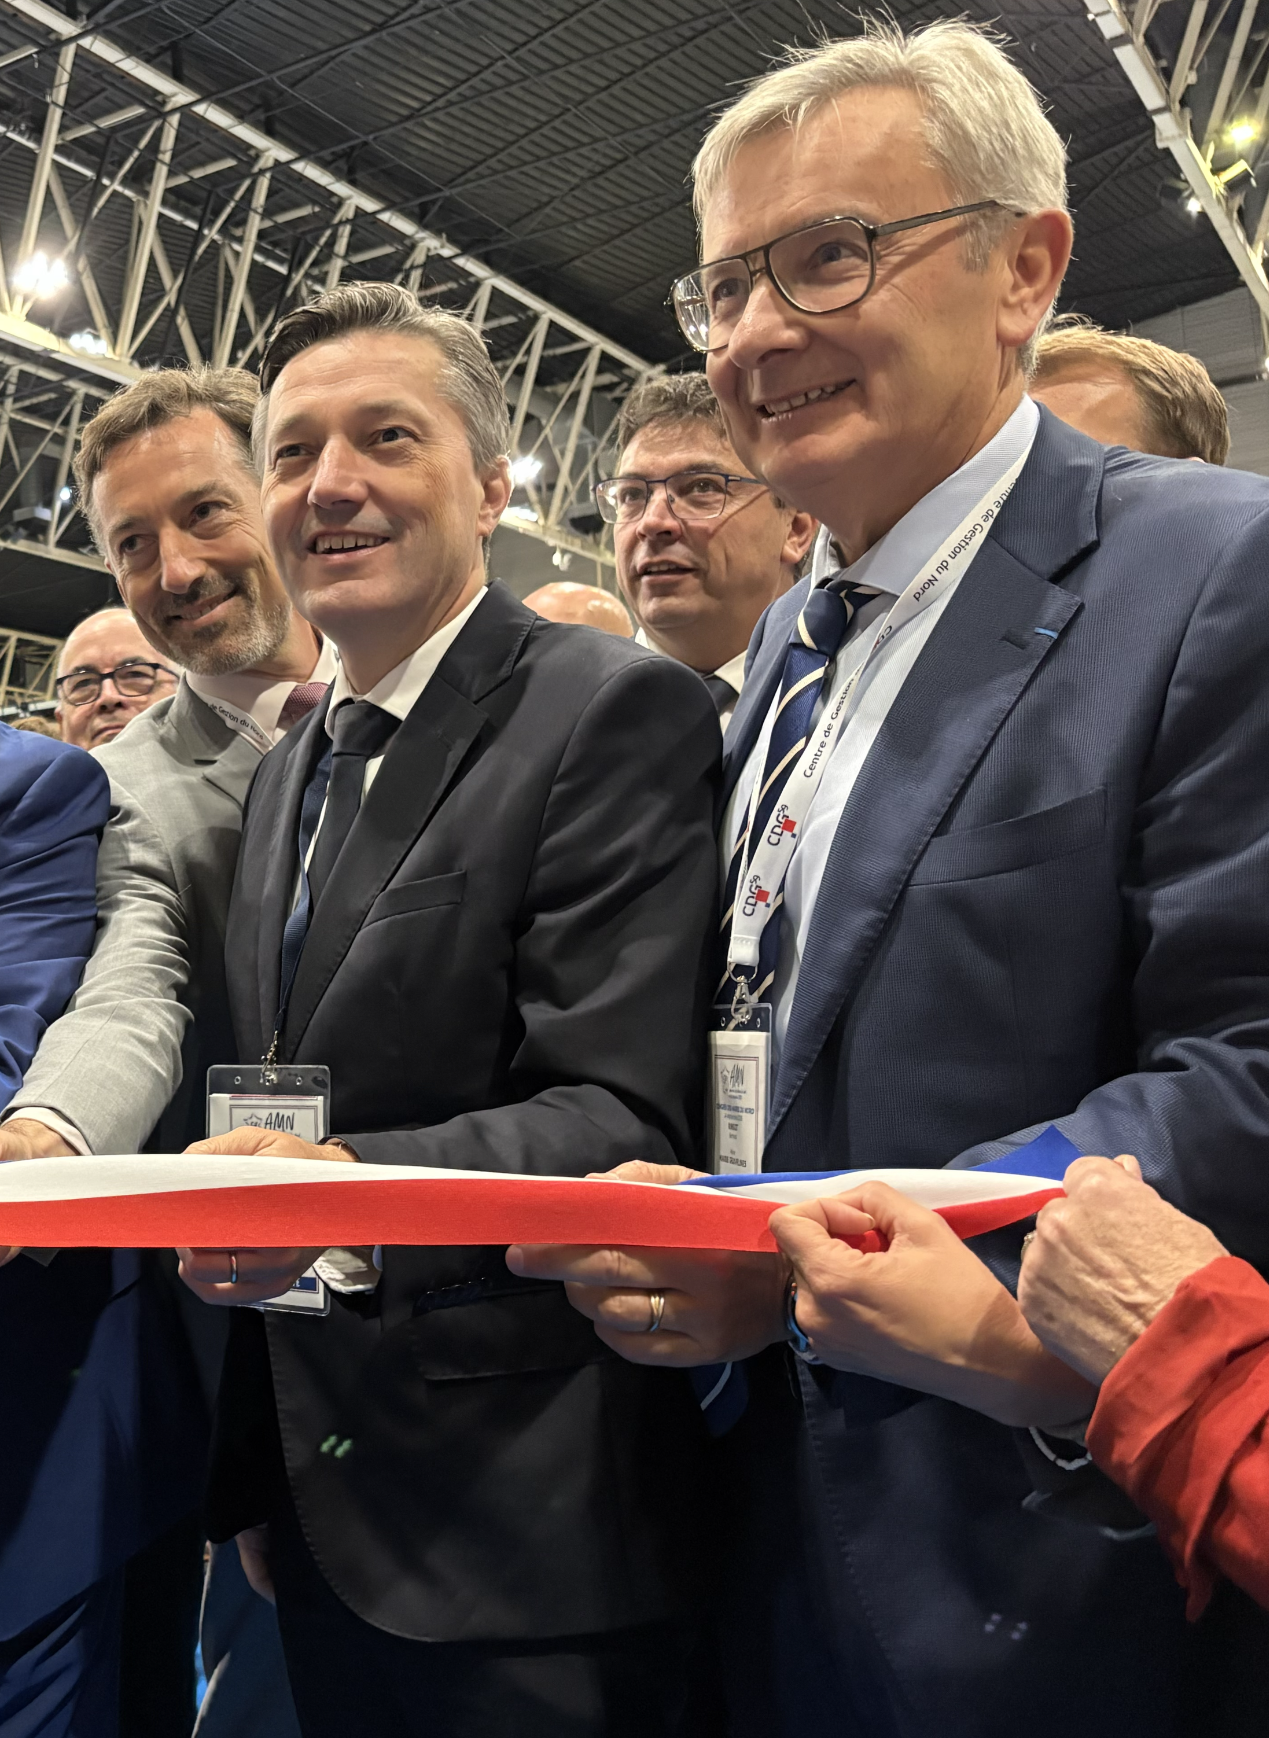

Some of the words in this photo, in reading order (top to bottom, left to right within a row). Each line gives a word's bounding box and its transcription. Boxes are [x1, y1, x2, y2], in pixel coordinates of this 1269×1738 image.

[981, 508, 995, 523] de
[948, 522, 984, 560] Gestion
[935, 559, 949, 575] du
[913, 574, 939, 602] Nord
[218, 706, 239, 723] Gestion
[240, 719, 250, 728] du
[804, 740, 827, 779] Centre
[823, 723, 833, 738] de
[831, 677, 855, 720] Gestion
[264, 1111, 295, 1132] AMN
